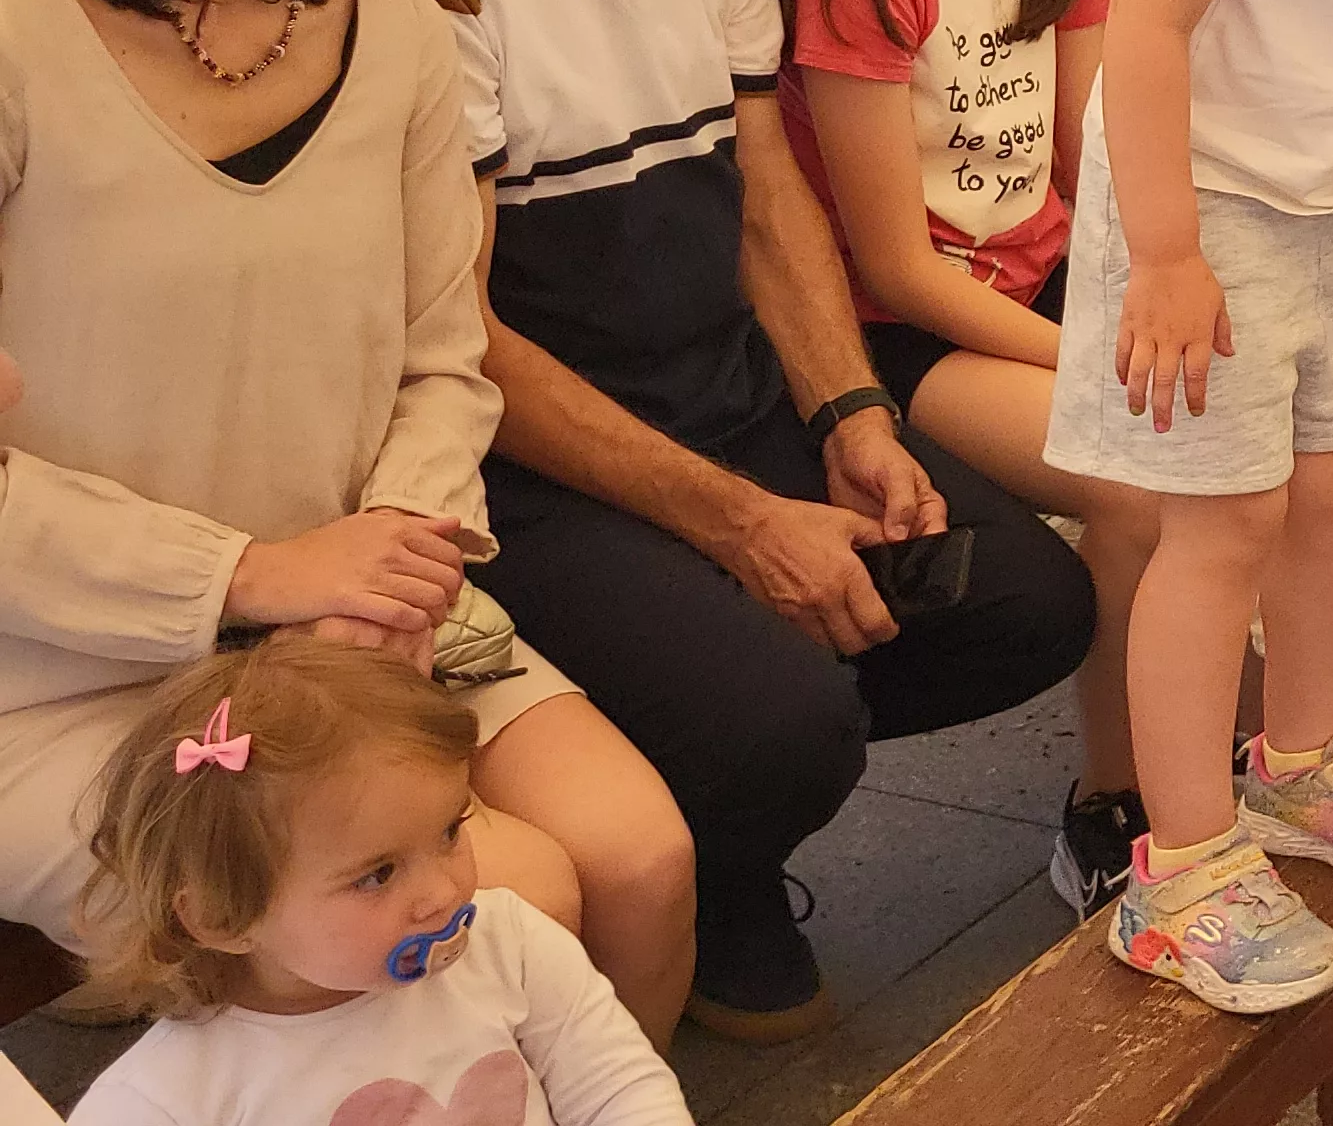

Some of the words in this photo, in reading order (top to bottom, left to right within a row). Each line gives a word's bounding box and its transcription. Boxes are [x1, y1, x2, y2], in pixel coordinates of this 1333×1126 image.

[944, 76, 970, 113] to
[975, 71, 1040, 107] others,
[948, 122, 986, 151] be
[995, 112, 1045, 159] good
[951, 158, 985, 191] to
